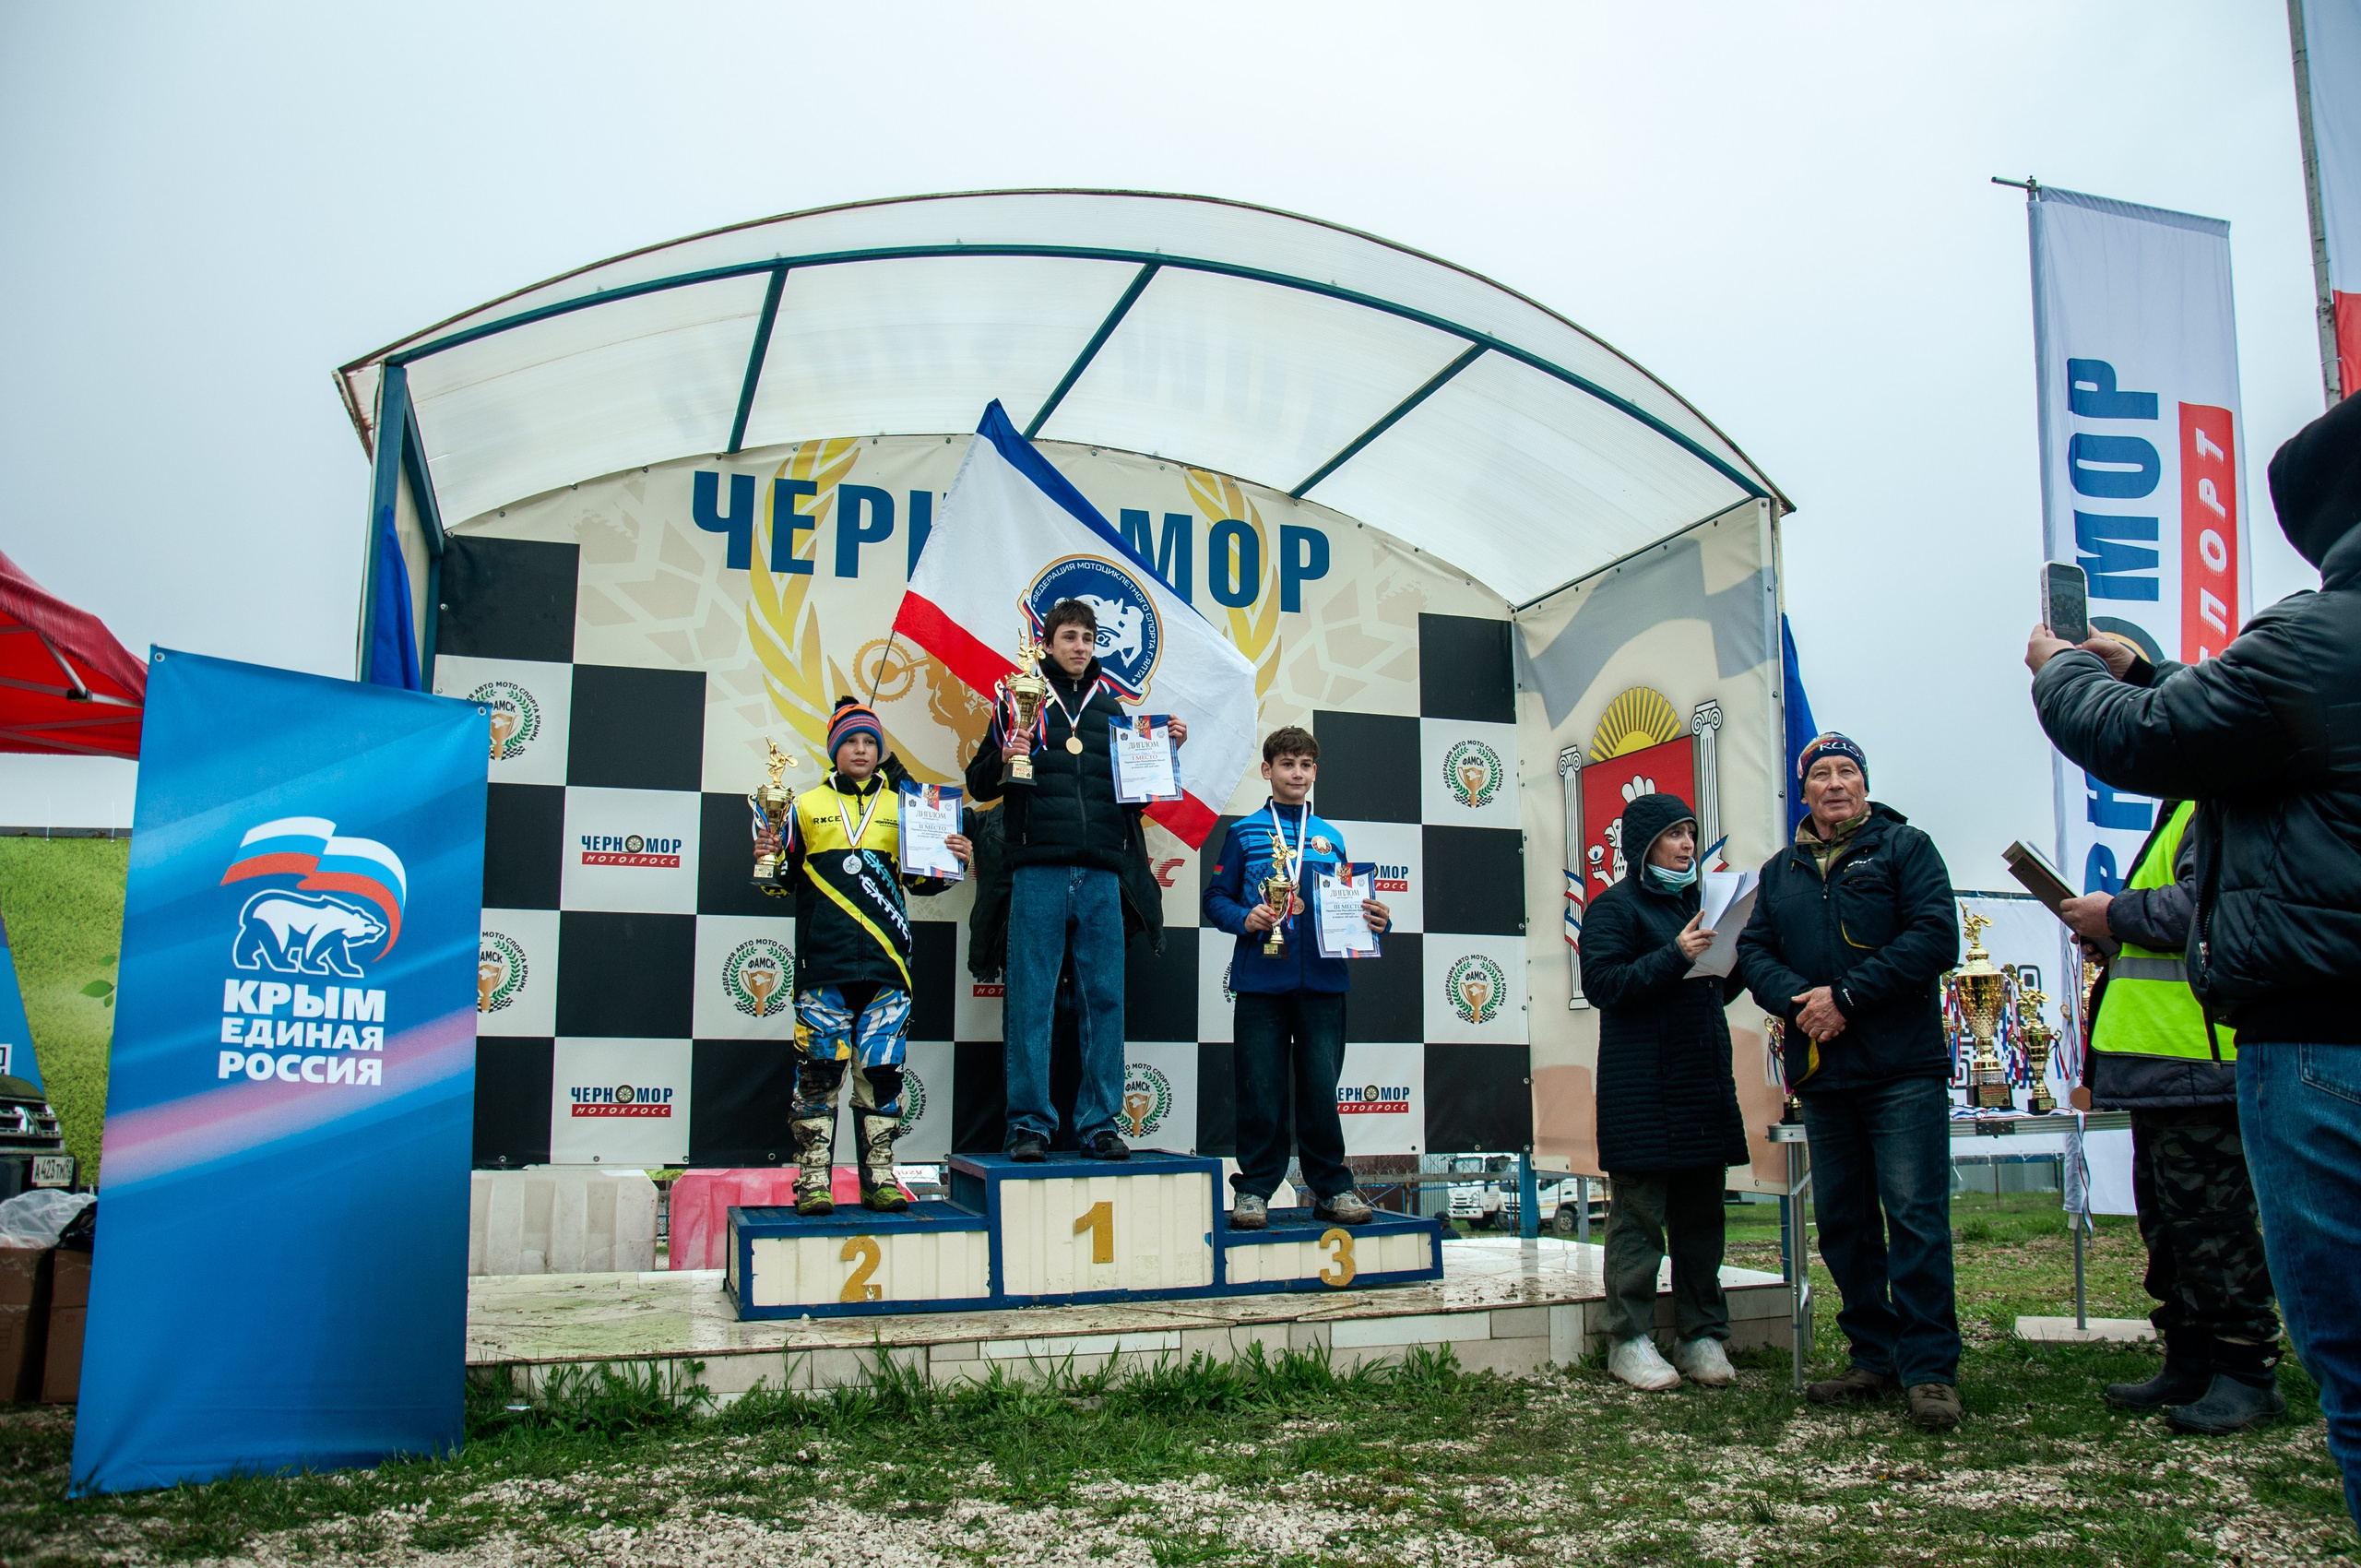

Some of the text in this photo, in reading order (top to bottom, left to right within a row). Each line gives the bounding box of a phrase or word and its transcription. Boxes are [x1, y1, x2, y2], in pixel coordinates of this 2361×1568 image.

[693, 470, 1330, 613] ЧЕРМОР
[1033, 563, 1076, 602] ФЕДЕРАЦИЯ
[1077, 562, 1149, 611] МОТОЦИКЛЕТНОГО
[1145, 612, 1157, 649] СПОРТА
[474, 682, 540, 742] АВТО МОТО СПОРТА КРЫМА
[492, 700, 516, 713] АМСК
[1128, 741, 1159, 750] ДИПЛОМ
[1462, 756, 1484, 767] ФАМСК
[1442, 740, 1503, 791] ФЕДЕРАЦИЯ АВТО МОТО СПОРТА КРЫМА
[916, 810, 946, 819] ДИПЛОМ
[586, 854, 678, 865] МОТОКРОСС
[1330, 889, 1360, 897] ДИПЛОМ
[480, 950, 504, 964] АМСК
[481, 931, 528, 992] МОТО СПОРТА КРЫМА
[722, 952, 736, 996] ФЕДЕРАЦИЯ
[736, 940, 753, 954] АВТО
[755, 938, 777, 947] МОТО
[747, 956, 777, 970] ФАМСК
[1445, 954, 1507, 1006] ФЕДЕРАЦИЯ АВТО МОТО СПОРТА КРЫМА
[1465, 970, 1488, 982] ФАМСК
[223, 979, 386, 1022] КРЫМ
[220, 1016, 385, 1051] ЕДИНАЯ
[218, 1051, 383, 1087] РОССИЯ
[1125, 1080, 1151, 1093] ФАМСК
[905, 1068, 927, 1121] СПОРТА КРЫМА
[1132, 1063, 1172, 1118] МОТО СПОРТА КРЫМА
[1337, 1104, 1406, 1112] ОТОКРОСС
[575, 1107, 669, 1115] МОТОКРОСС
[1074, 1201, 1114, 1264] 1
[839, 1235, 882, 1302] 2
[1319, 1228, 1356, 1287] 3
